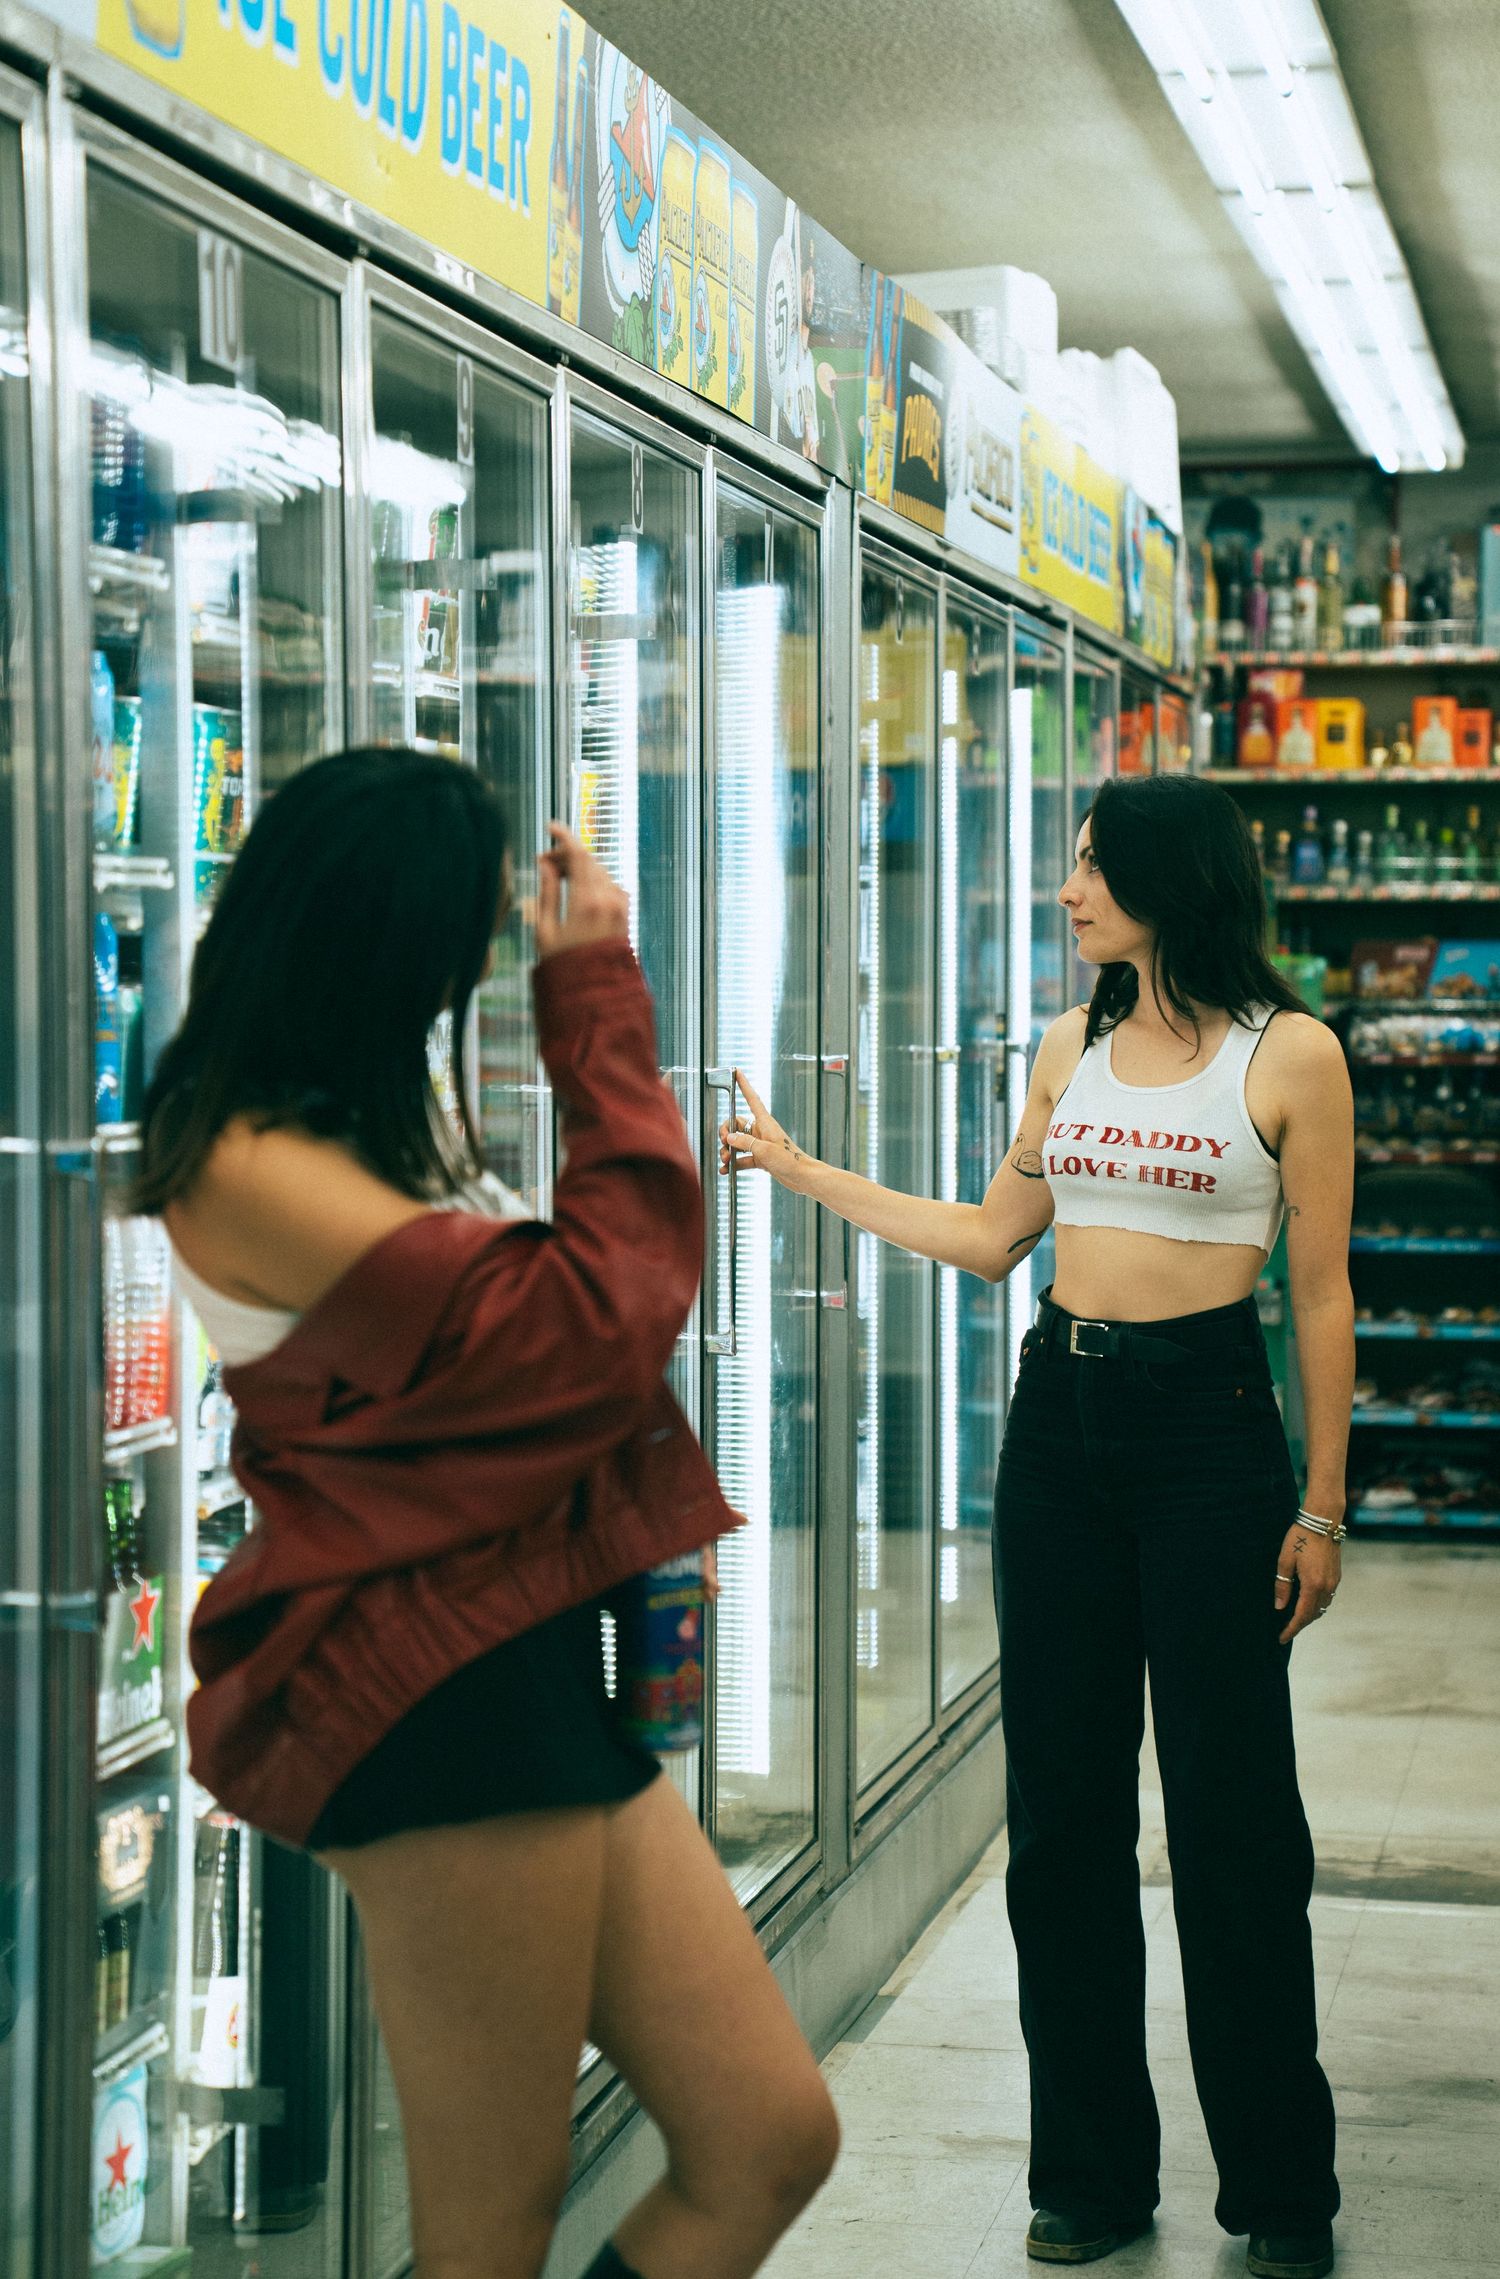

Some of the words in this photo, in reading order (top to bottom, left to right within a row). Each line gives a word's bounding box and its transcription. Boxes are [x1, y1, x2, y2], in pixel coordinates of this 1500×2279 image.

[318, 0, 428, 148] COLD
[441, 3, 531, 213] BEER
[205, 247, 238, 364] 10
[459, 360, 470, 459] 9
[633, 444, 642, 529] 8
[1049, 1155, 1128, 1179] LOVE
[1138, 1164, 1218, 1195] HER
[1098, 1126, 1232, 1160] DADDY
